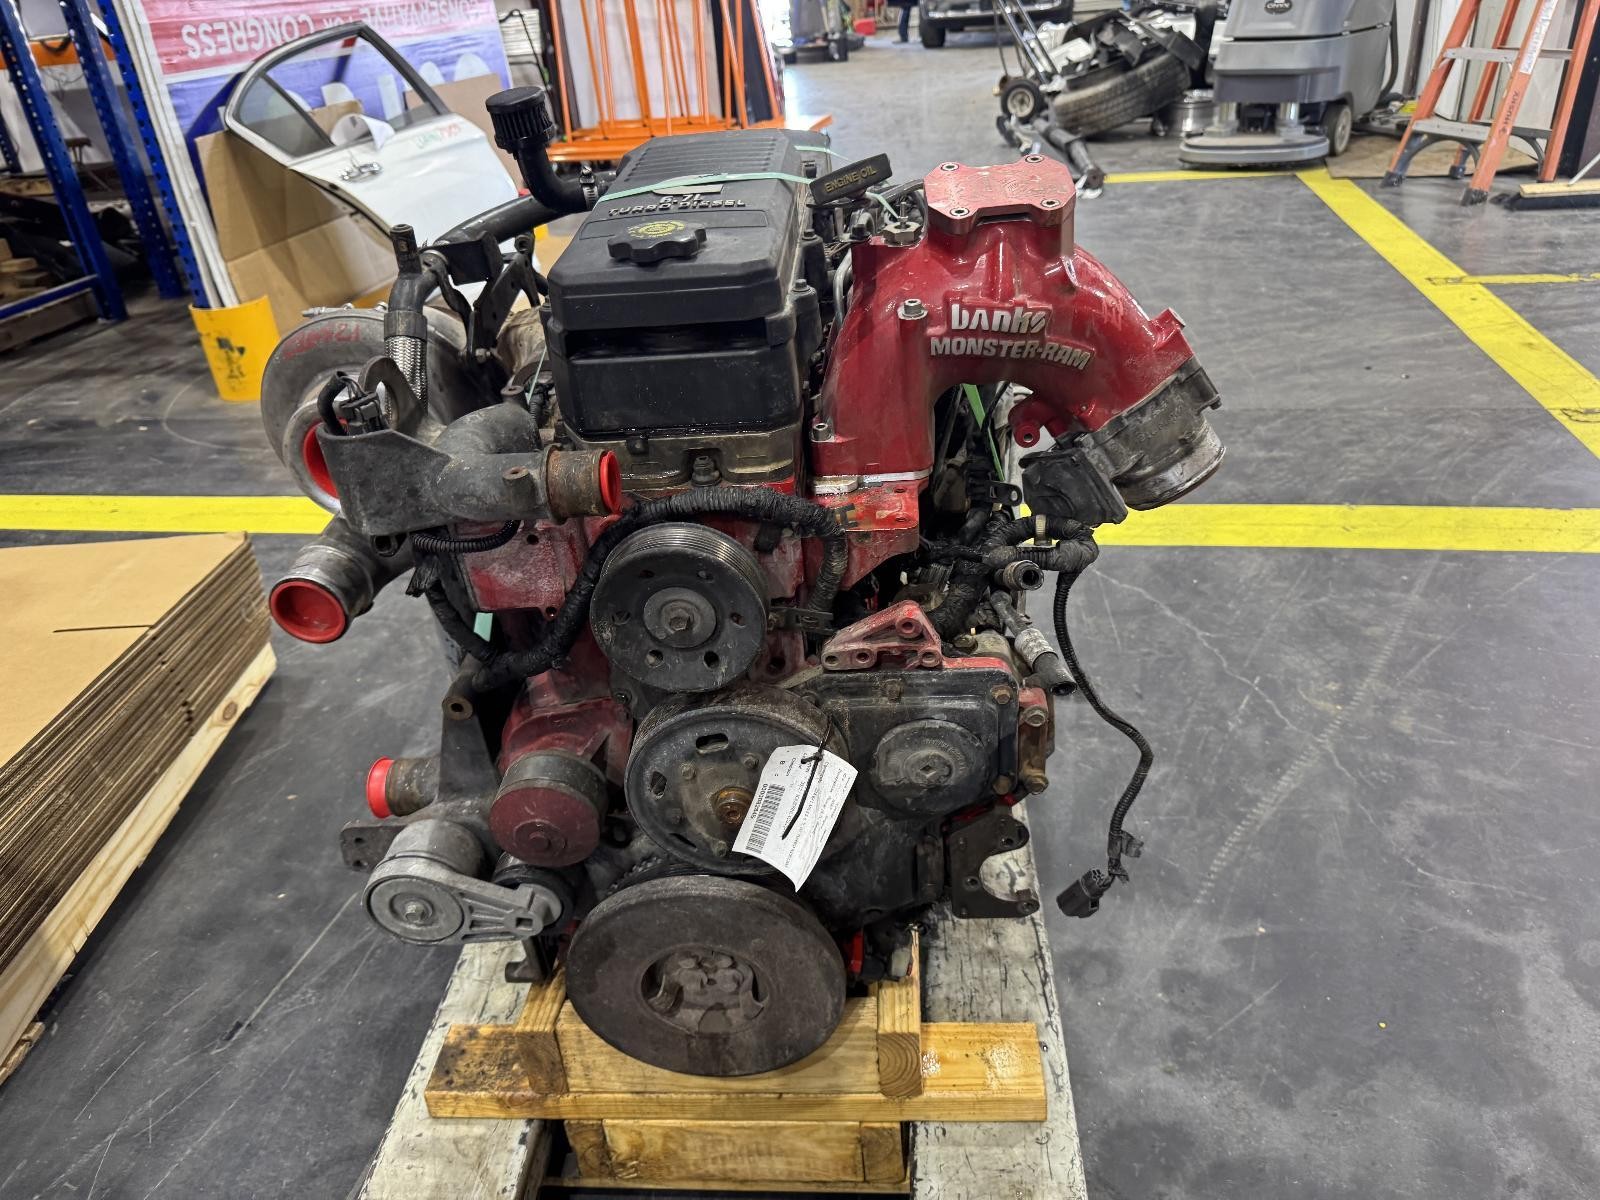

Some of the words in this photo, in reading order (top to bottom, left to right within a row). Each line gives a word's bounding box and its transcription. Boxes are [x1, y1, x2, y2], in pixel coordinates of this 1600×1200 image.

[181, 14, 315, 59] CONGRESS
[824, 173, 860, 193] ENGINE
[859, 164, 878, 183] OIL
[608, 202, 672, 216] TURBO
[678, 199, 746, 210] DIESEL
[930, 336, 1092, 370] MONSTER-RAM
